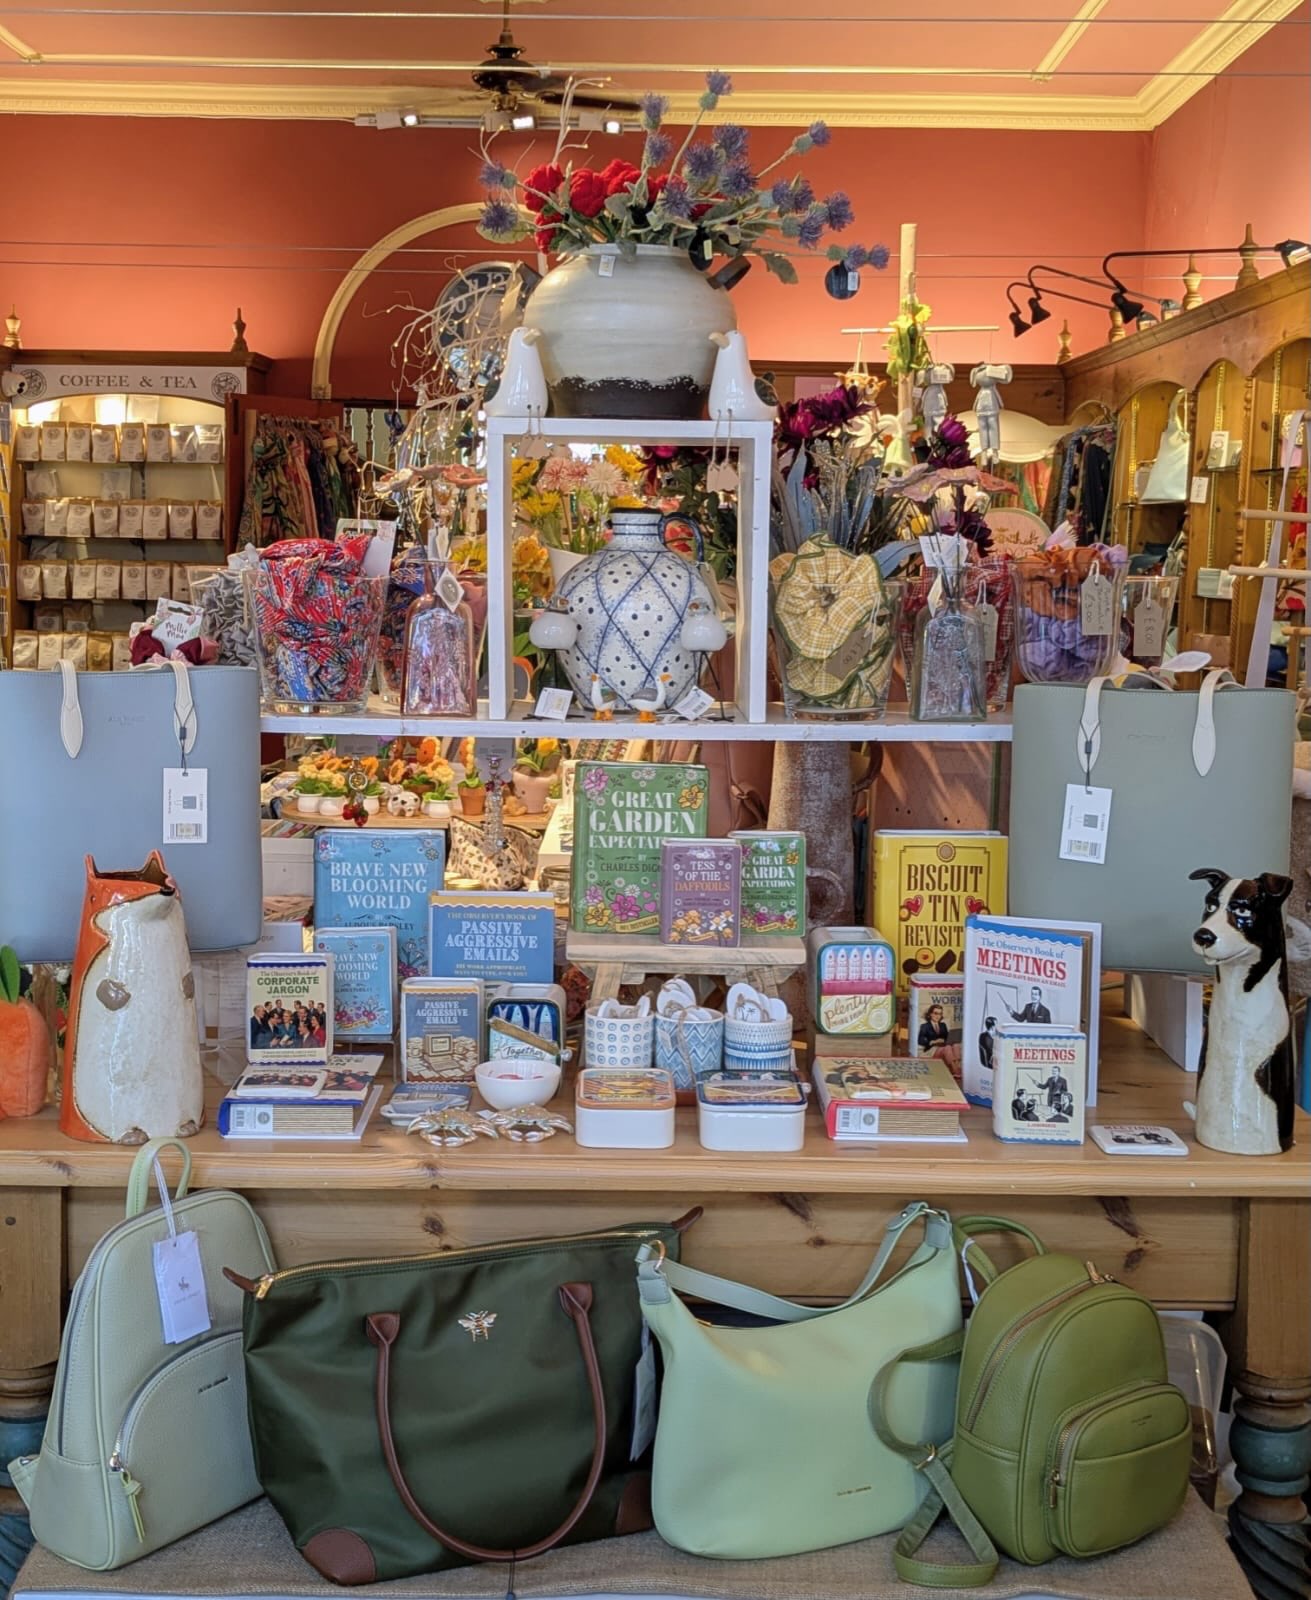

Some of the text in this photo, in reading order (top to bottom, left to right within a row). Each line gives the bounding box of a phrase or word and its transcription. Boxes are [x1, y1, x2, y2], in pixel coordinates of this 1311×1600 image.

[59, 375, 197, 389] COFFEE & TEA
[611, 790, 675, 809] GREAT
[589, 809, 697, 834] GARDEN
[589, 835, 661, 849] EXPECTAT
[690, 861, 716, 870] TESS
[752, 856, 785, 865] GREAT
[331, 862, 429, 877] BRAVE NEW
[601, 863, 640, 872] CHARLES
[742, 866, 796, 879] GARDEN
[685, 871, 721, 881] OF THE
[907, 864, 983, 893] BISCUIT
[331, 878, 428, 893] BLOOMING
[675, 882, 731, 892] DAFFODILS
[347, 895, 411, 909] WORLD
[928, 895, 961, 922] TIN
[461, 921, 522, 935] PASSIVE
[445, 934, 538, 949] AGGRESSIVE
[905, 925, 964, 947] REVISIT
[463, 947, 520, 962] EMAILS
[981, 937, 1065, 959] The Observer's Book of
[357, 953, 378, 962] NEW
[976, 947, 1066, 981] MEETINGS
[336, 962, 379, 971] OOMING
[257, 977, 320, 986] CORPORATE
[336, 972, 370, 981] WORLD
[267, 986, 310, 994] JARGON
[424, 1001, 459, 1009] PASSIVE
[416, 1008, 469, 1017] AGGRESSIVE
[426, 1016, 458, 1025] EMAILS
[1013, 1048, 1076, 1061] MEETINGS
